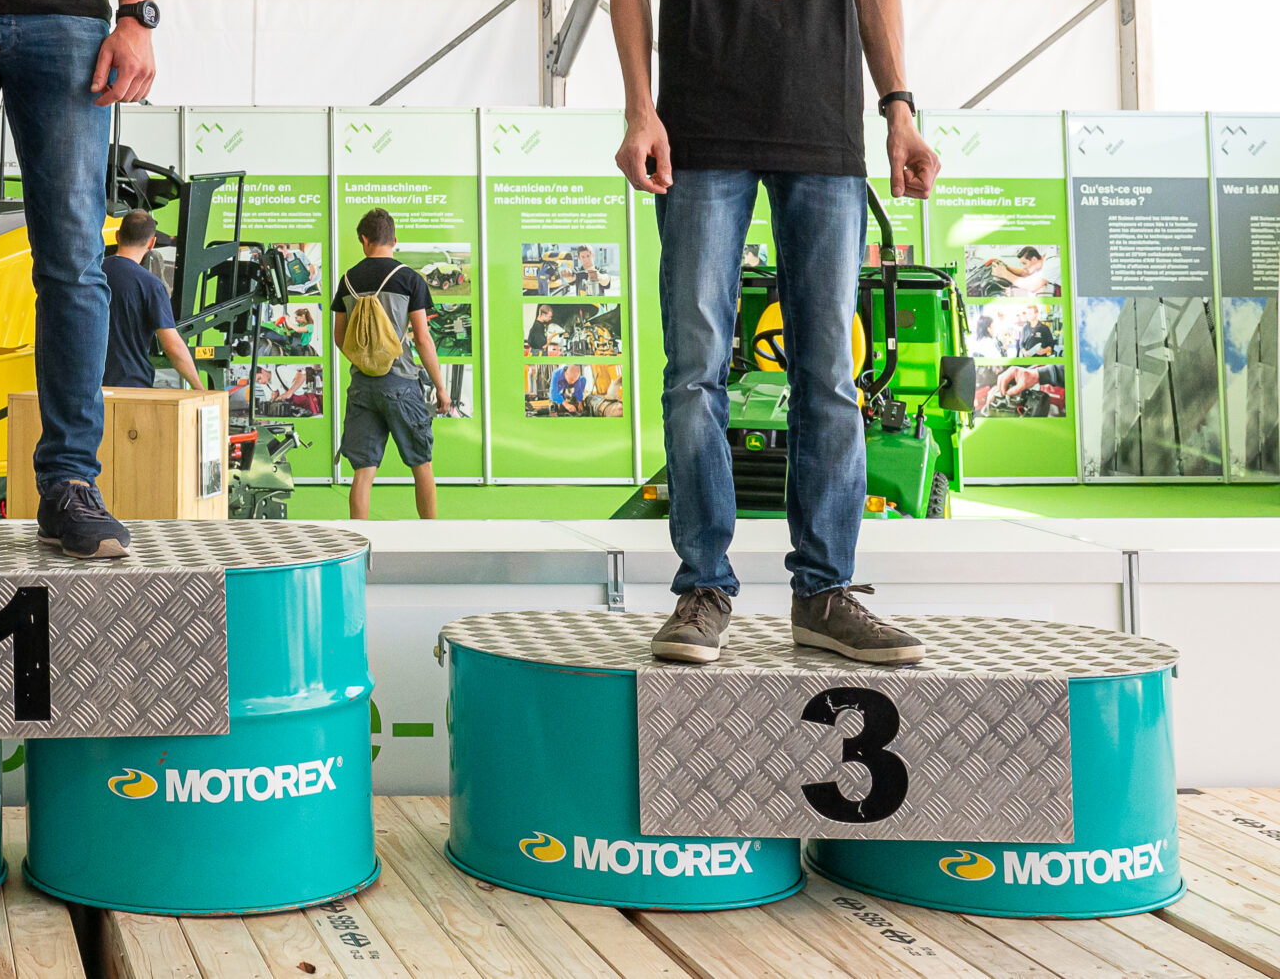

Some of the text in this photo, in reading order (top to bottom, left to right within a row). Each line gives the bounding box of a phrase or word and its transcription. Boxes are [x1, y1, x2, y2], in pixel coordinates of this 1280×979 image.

[278, 184, 291, 192] en
[345, 182, 432, 192] Landmaschinen-
[493, 182, 583, 193] Mécanicien/ne en
[935, 184, 1004, 196] Motorgeräte-
[1080, 184, 1153, 196] Qu'est-ce que
[1222, 184, 1280, 195] Wer ist AM
[248, 194, 296, 206] agricoles
[298, 194, 321, 204] CFC
[345, 194, 448, 204] mechaniker/in EFZ
[493, 195, 625, 205] machines de chantier CFC
[936, 196, 1036, 207] mechaniker/in EFZ
[1080, 196, 1099, 206] AM
[800, 686, 909, 824] 3
